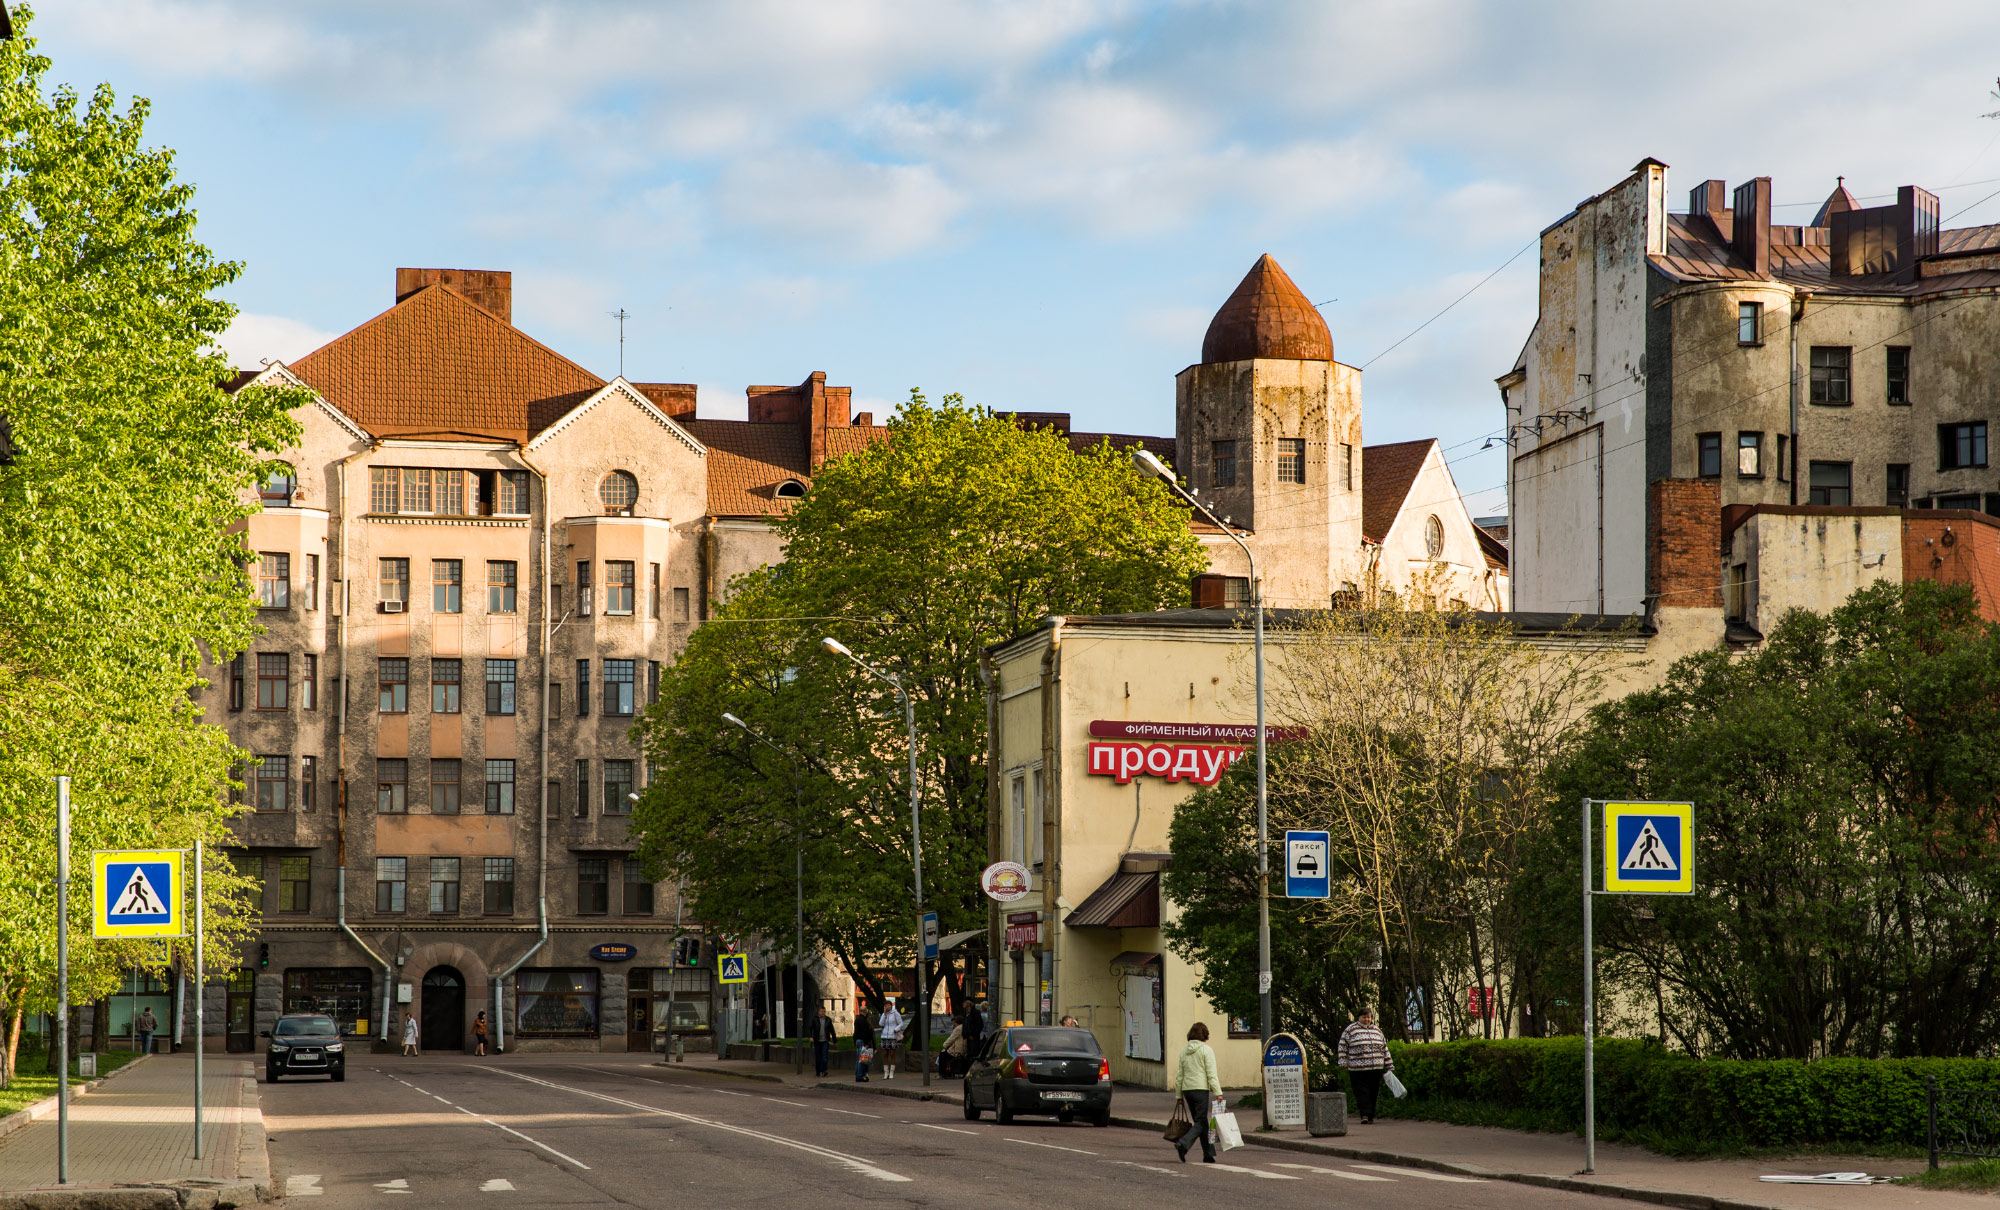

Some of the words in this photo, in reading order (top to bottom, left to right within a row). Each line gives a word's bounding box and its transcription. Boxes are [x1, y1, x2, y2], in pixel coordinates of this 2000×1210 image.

[1125, 724, 1212, 737] ФИРМЕННЫЙ
[1215, 728, 1275, 738] МАГАЗН
[1093, 746, 1244, 782] продук
[1007, 926, 1036, 947] продукты
[1270, 1045, 1299, 1060] Визит
